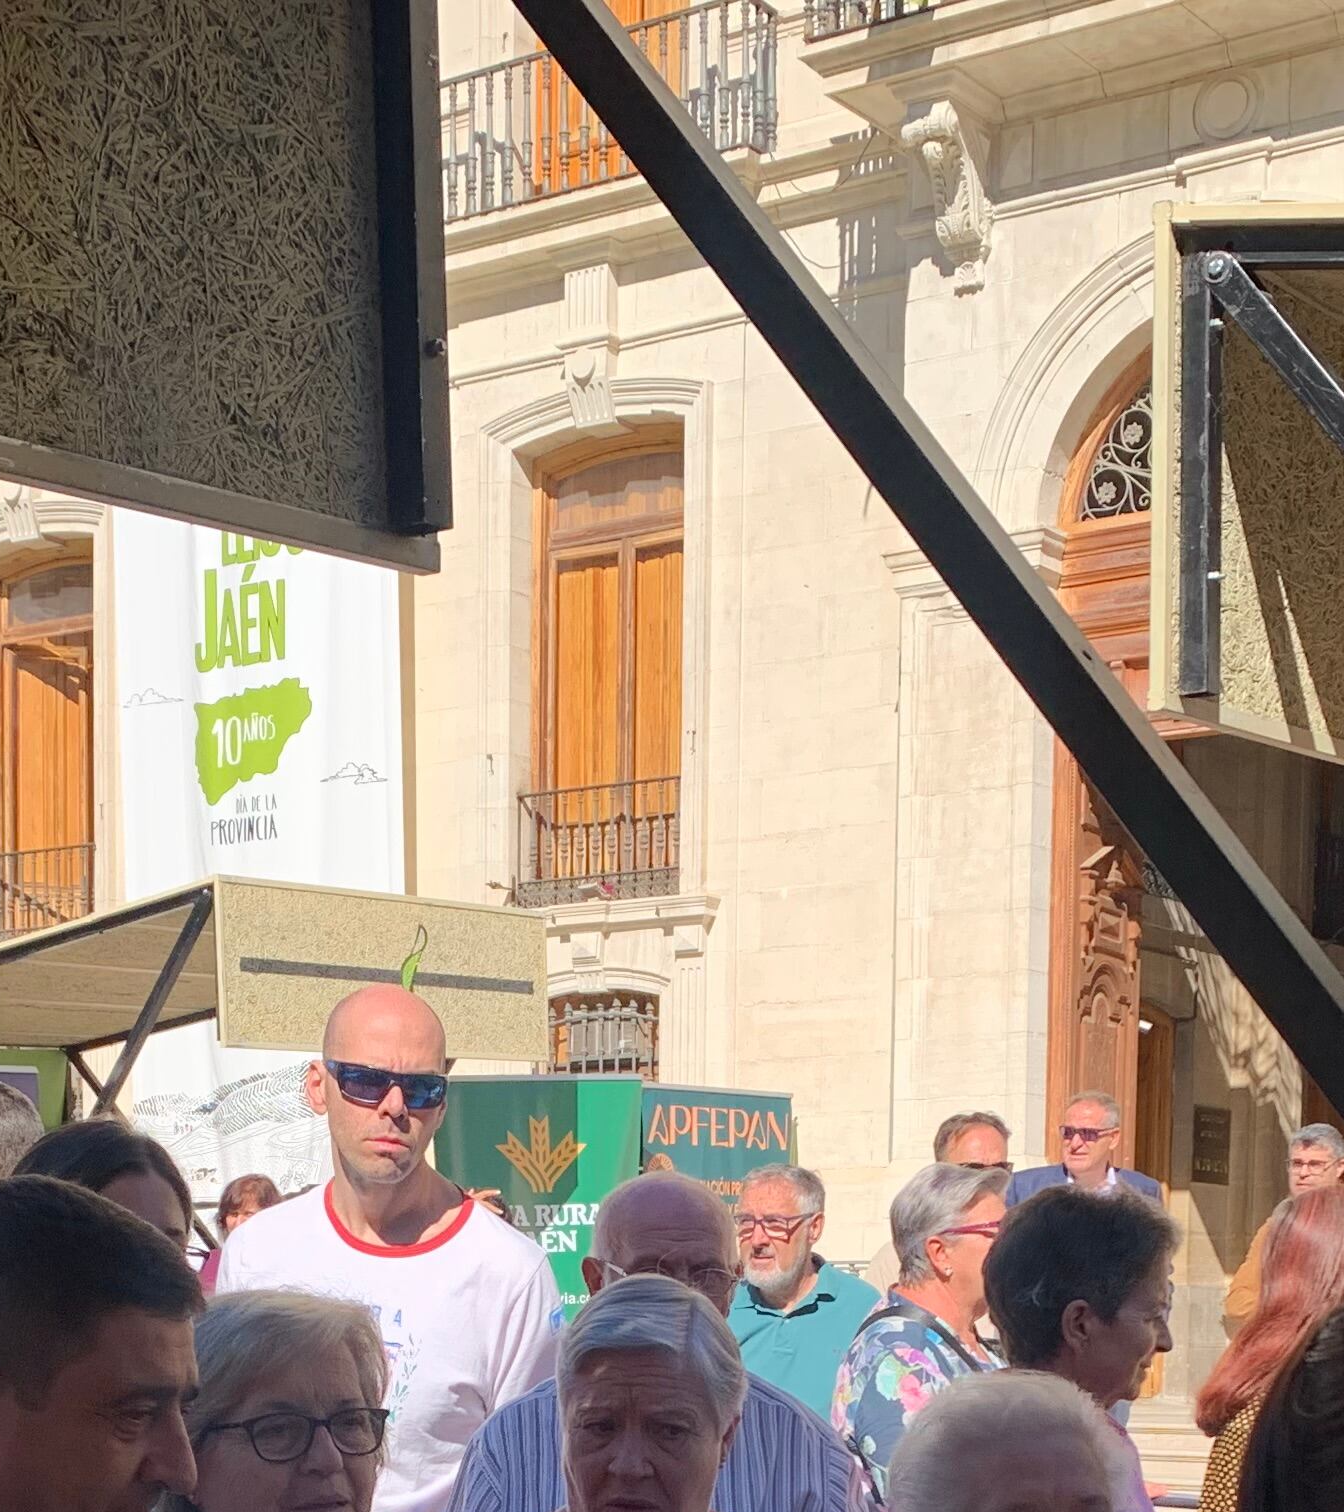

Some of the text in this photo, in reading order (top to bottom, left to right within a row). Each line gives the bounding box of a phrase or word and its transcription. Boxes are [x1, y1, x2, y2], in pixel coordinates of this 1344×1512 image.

[194, 563, 286, 673] JAÉN
[211, 712, 276, 768] 10 AÑOS
[251, 795, 261, 812] DE
[265, 793, 277, 811] LA
[210, 814, 278, 846] PROVINCIA
[647, 1103, 789, 1151] APFEPAN
